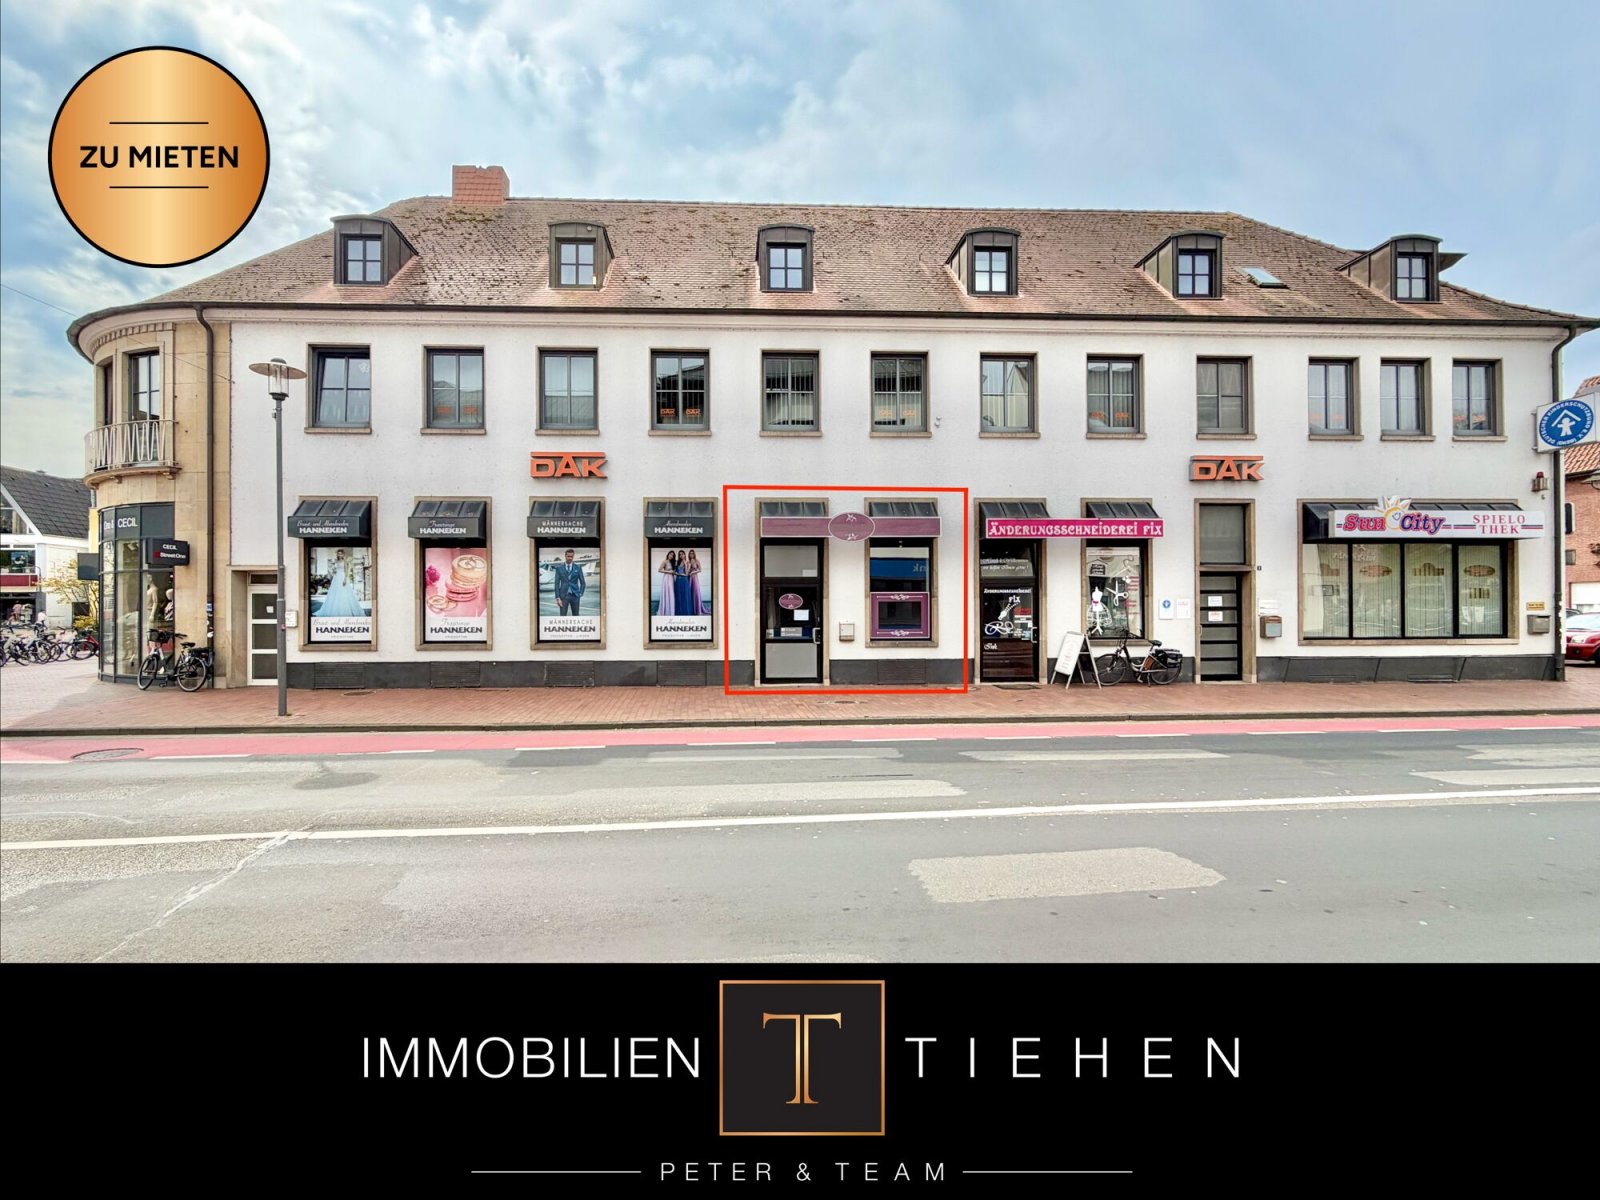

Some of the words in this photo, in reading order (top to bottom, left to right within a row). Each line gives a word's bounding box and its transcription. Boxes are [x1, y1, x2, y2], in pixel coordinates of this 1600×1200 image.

[530, 452, 608, 479] DAK
[1190, 455, 1264, 481] DAK
[117, 517, 138, 528] CECIL
[1343, 513, 1387, 532] Sun
[1400, 512, 1445, 535] City
[1473, 514, 1526, 525] SPIELO
[1480, 524, 1520, 535] THEK
[543, 625, 596, 633] HANNEKEN
